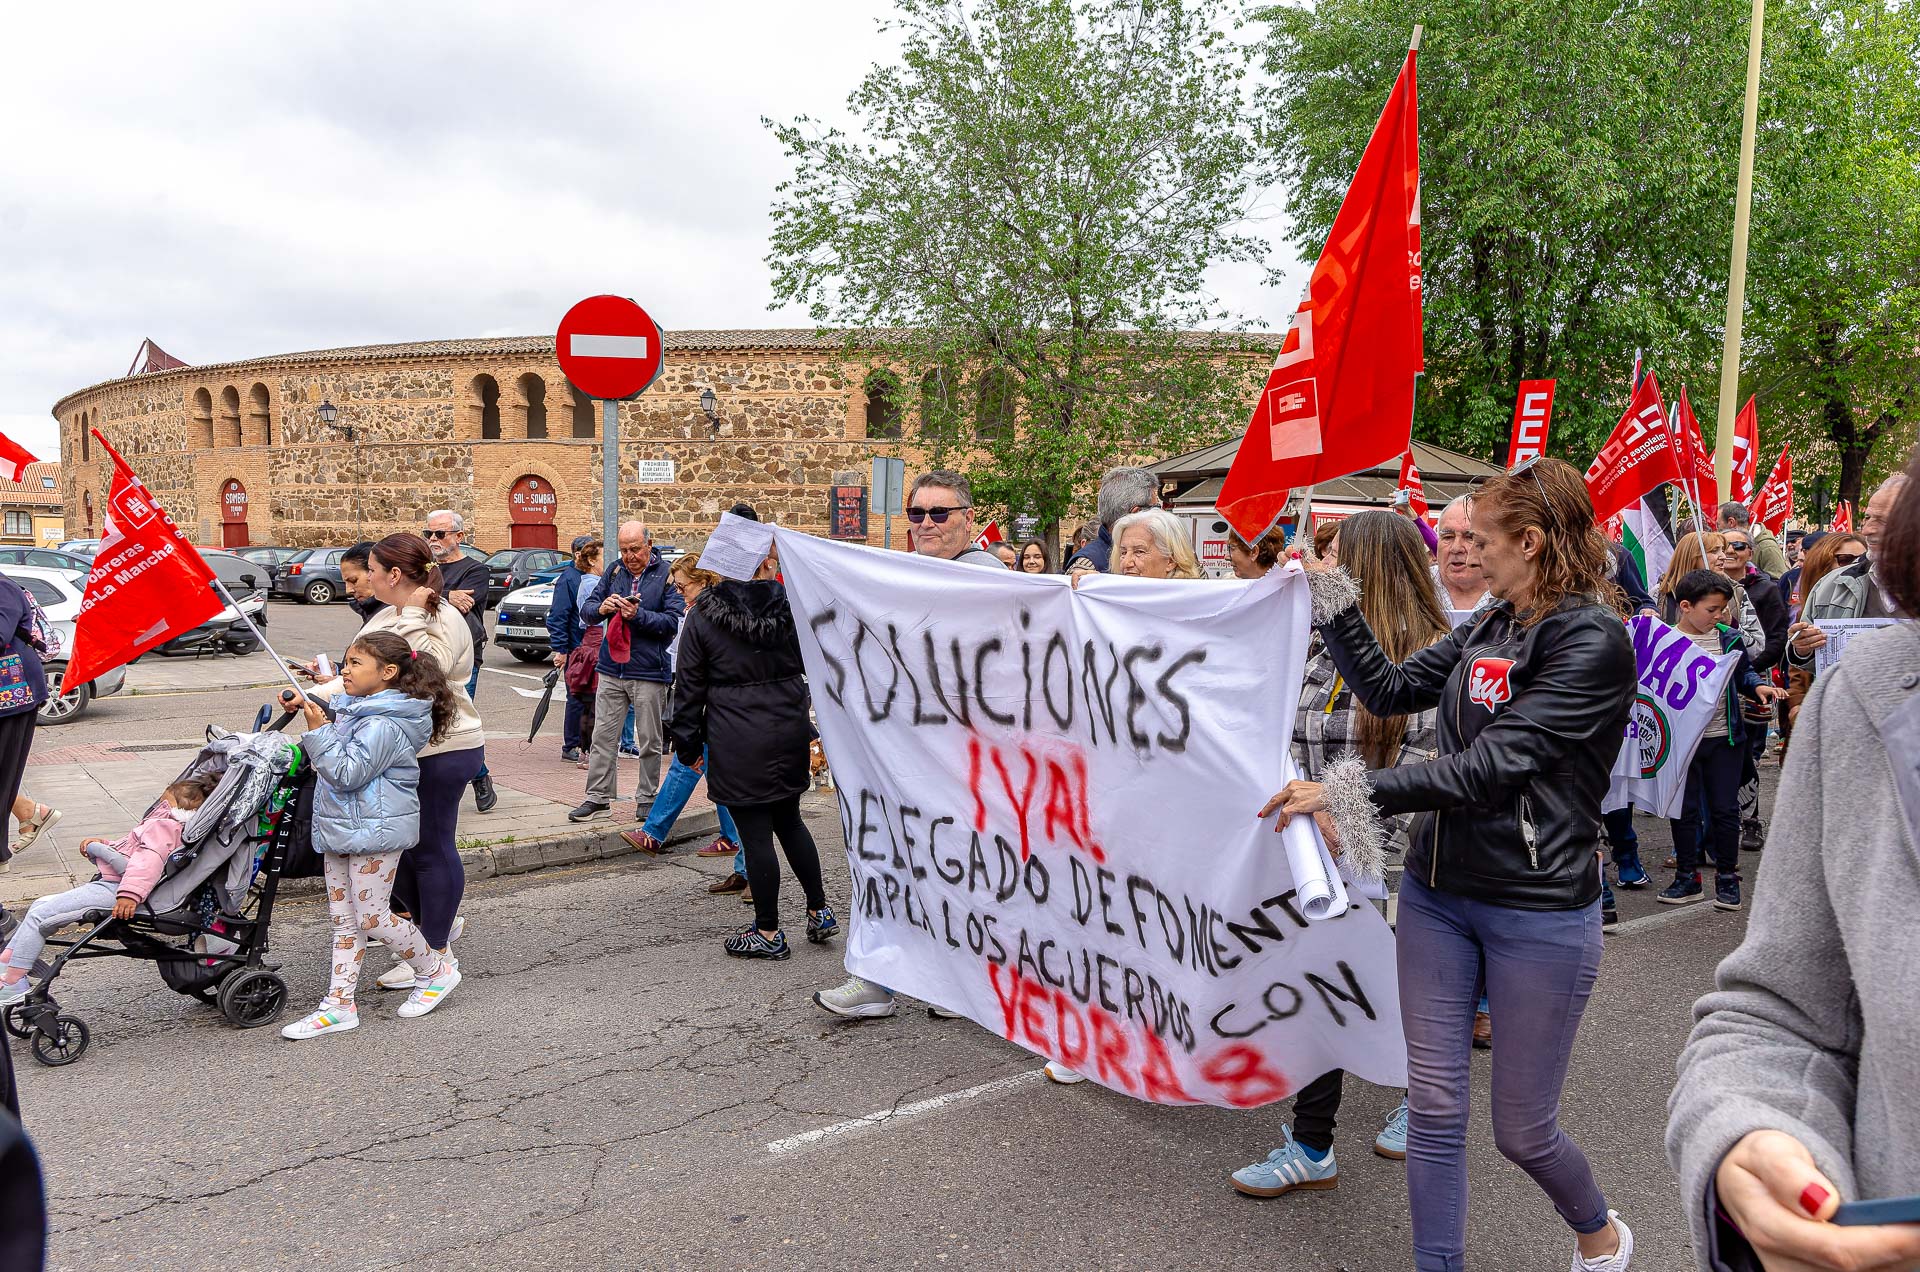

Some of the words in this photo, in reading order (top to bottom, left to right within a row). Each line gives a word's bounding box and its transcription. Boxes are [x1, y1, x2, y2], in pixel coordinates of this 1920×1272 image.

[513, 493, 526, 504] SOL
[530, 493, 556, 504] SOMBRA
[88, 542, 145, 584] obreras
[114, 543, 175, 586] Mancha
[271, 786, 299, 872] LITEWAY
[942, 899, 1007, 966] LOS
[1017, 928, 1196, 1055] ACUERDOS
[1209, 960, 1378, 1039] CON
[986, 960, 1200, 1104] VEDRA
